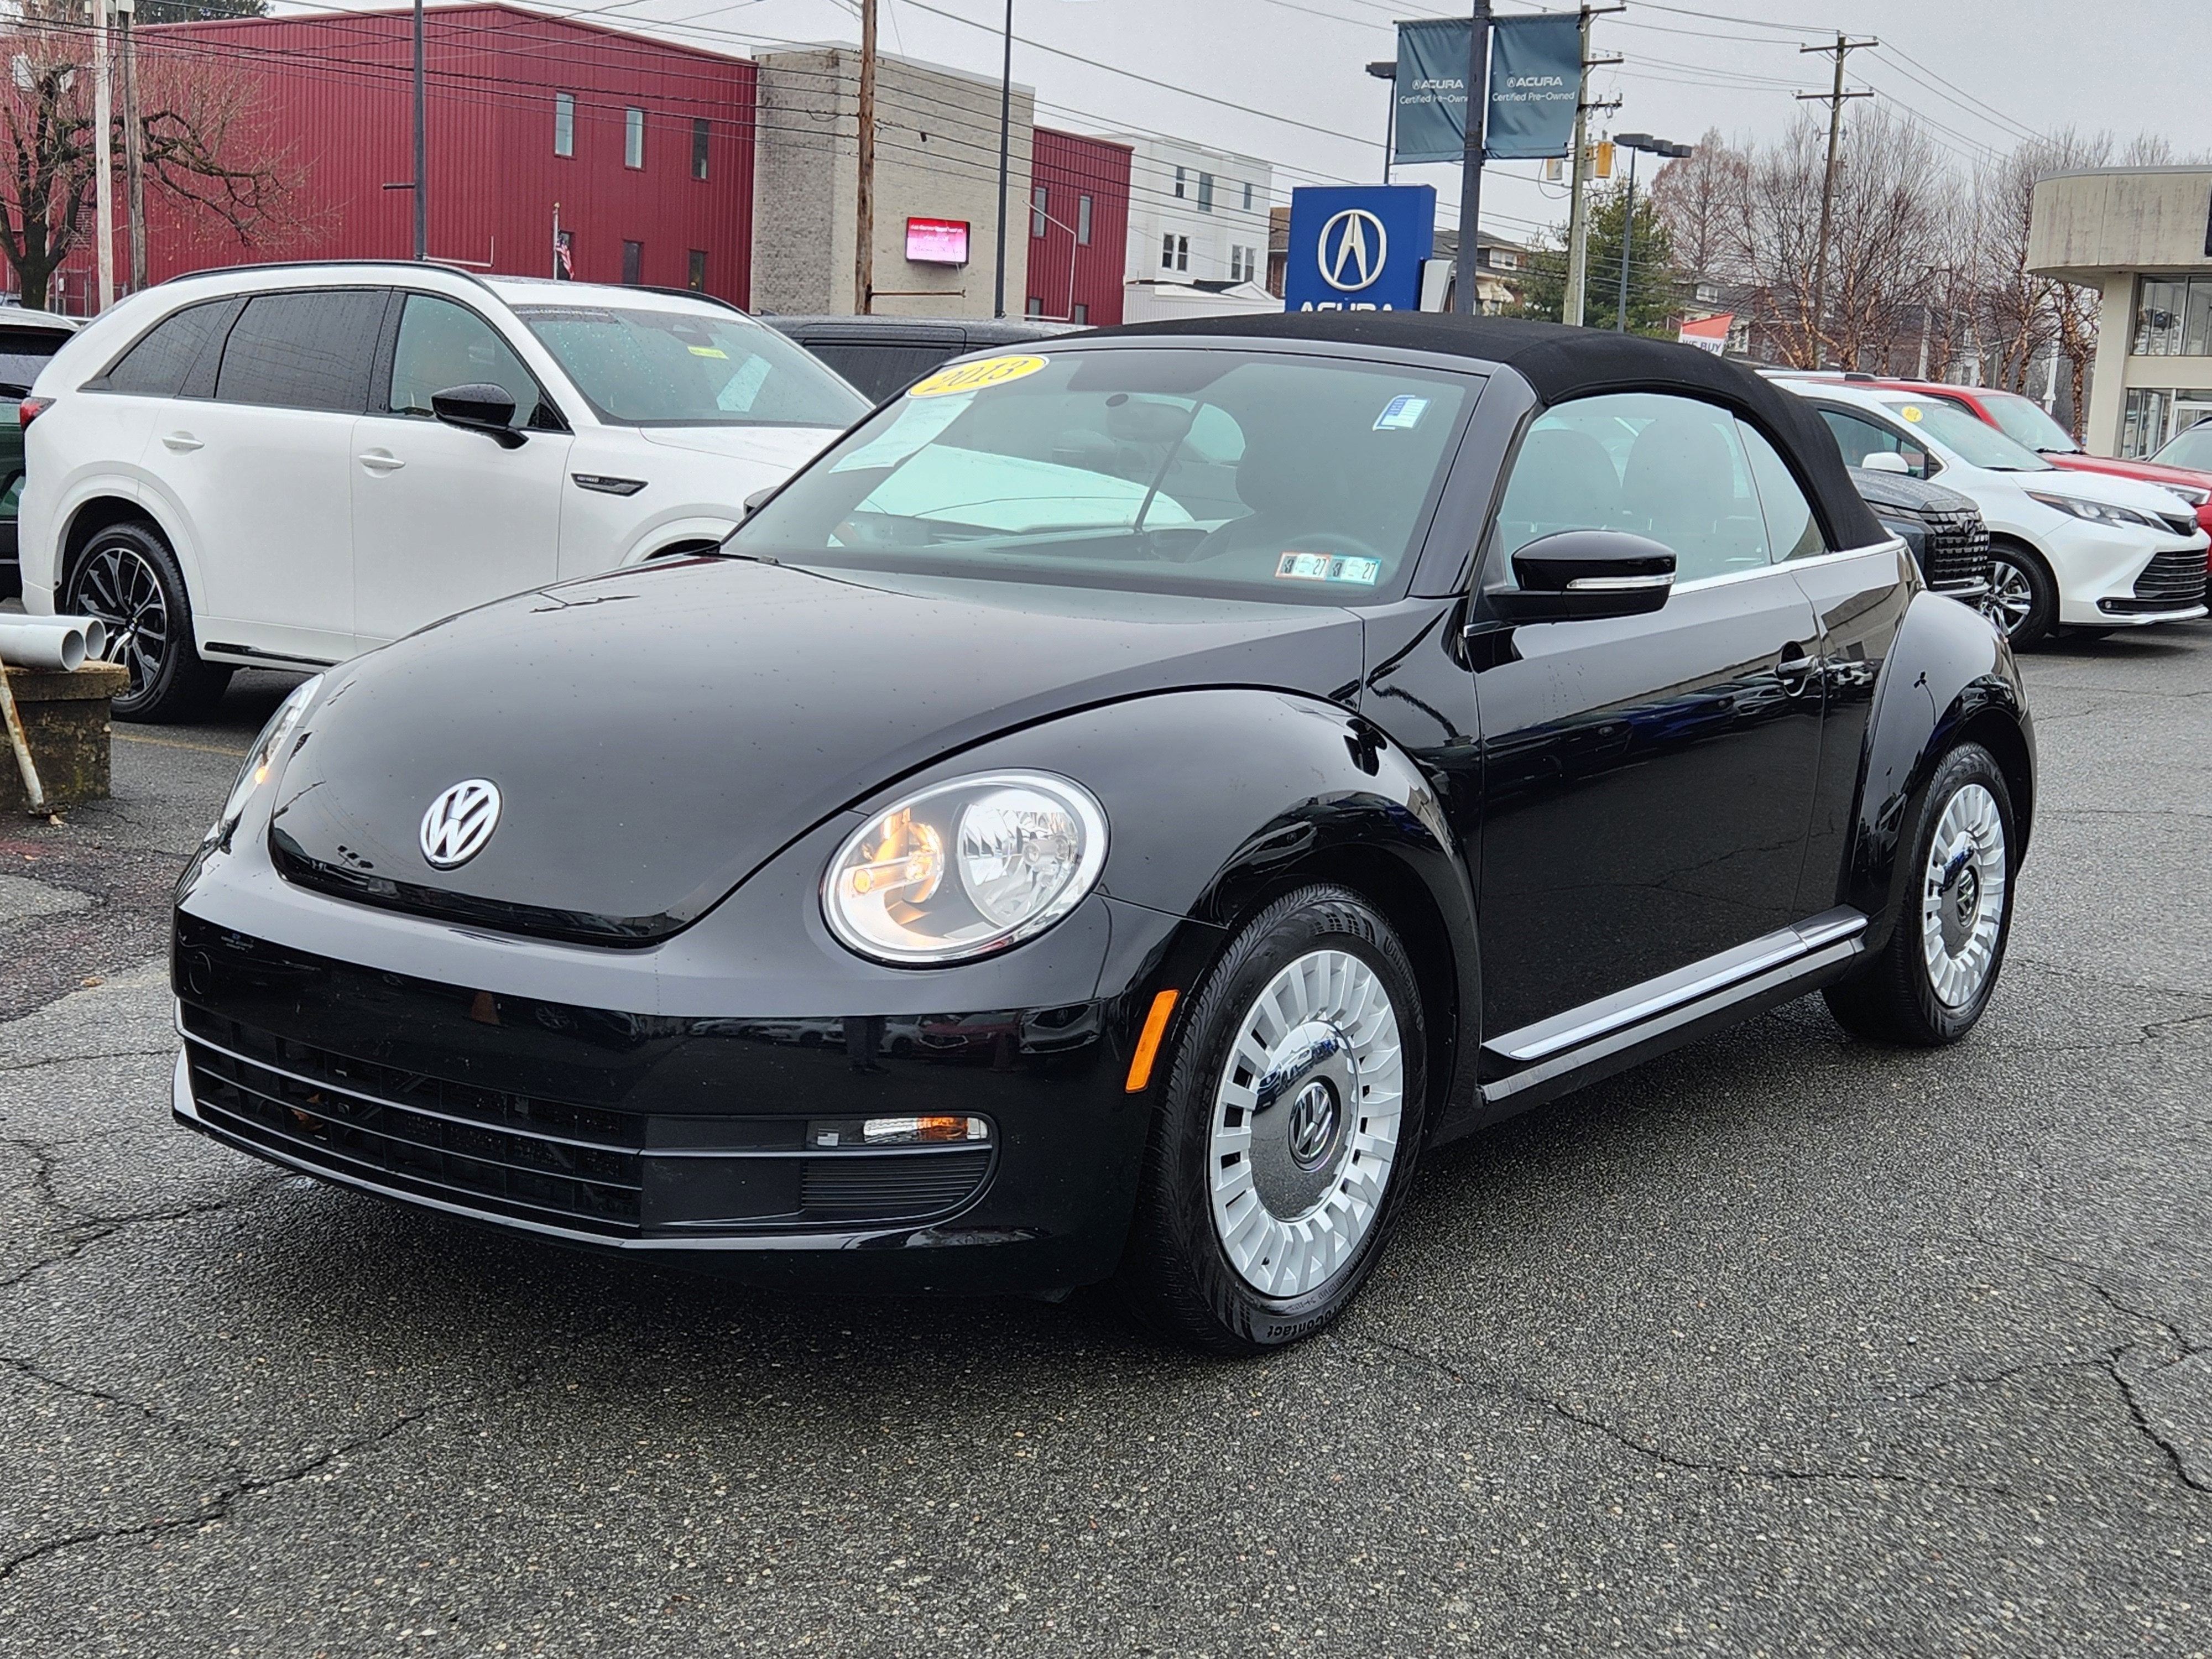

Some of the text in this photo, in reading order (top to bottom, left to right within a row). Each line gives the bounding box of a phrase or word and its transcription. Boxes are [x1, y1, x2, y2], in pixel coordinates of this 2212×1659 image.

[1421, 79, 1464, 89] ACURA
[1516, 76, 1563, 87] ACURA
[1399, 95, 1431, 105] Certified
[1492, 91, 1575, 102] Certified Pre-Owned
[1700, 341, 1722, 352] BUY
[922, 359, 1031, 393] 2013
[1284, 558, 1327, 576] 3 27
[1332, 562, 1377, 581] 3 27
[421, 779, 500, 864] VW
